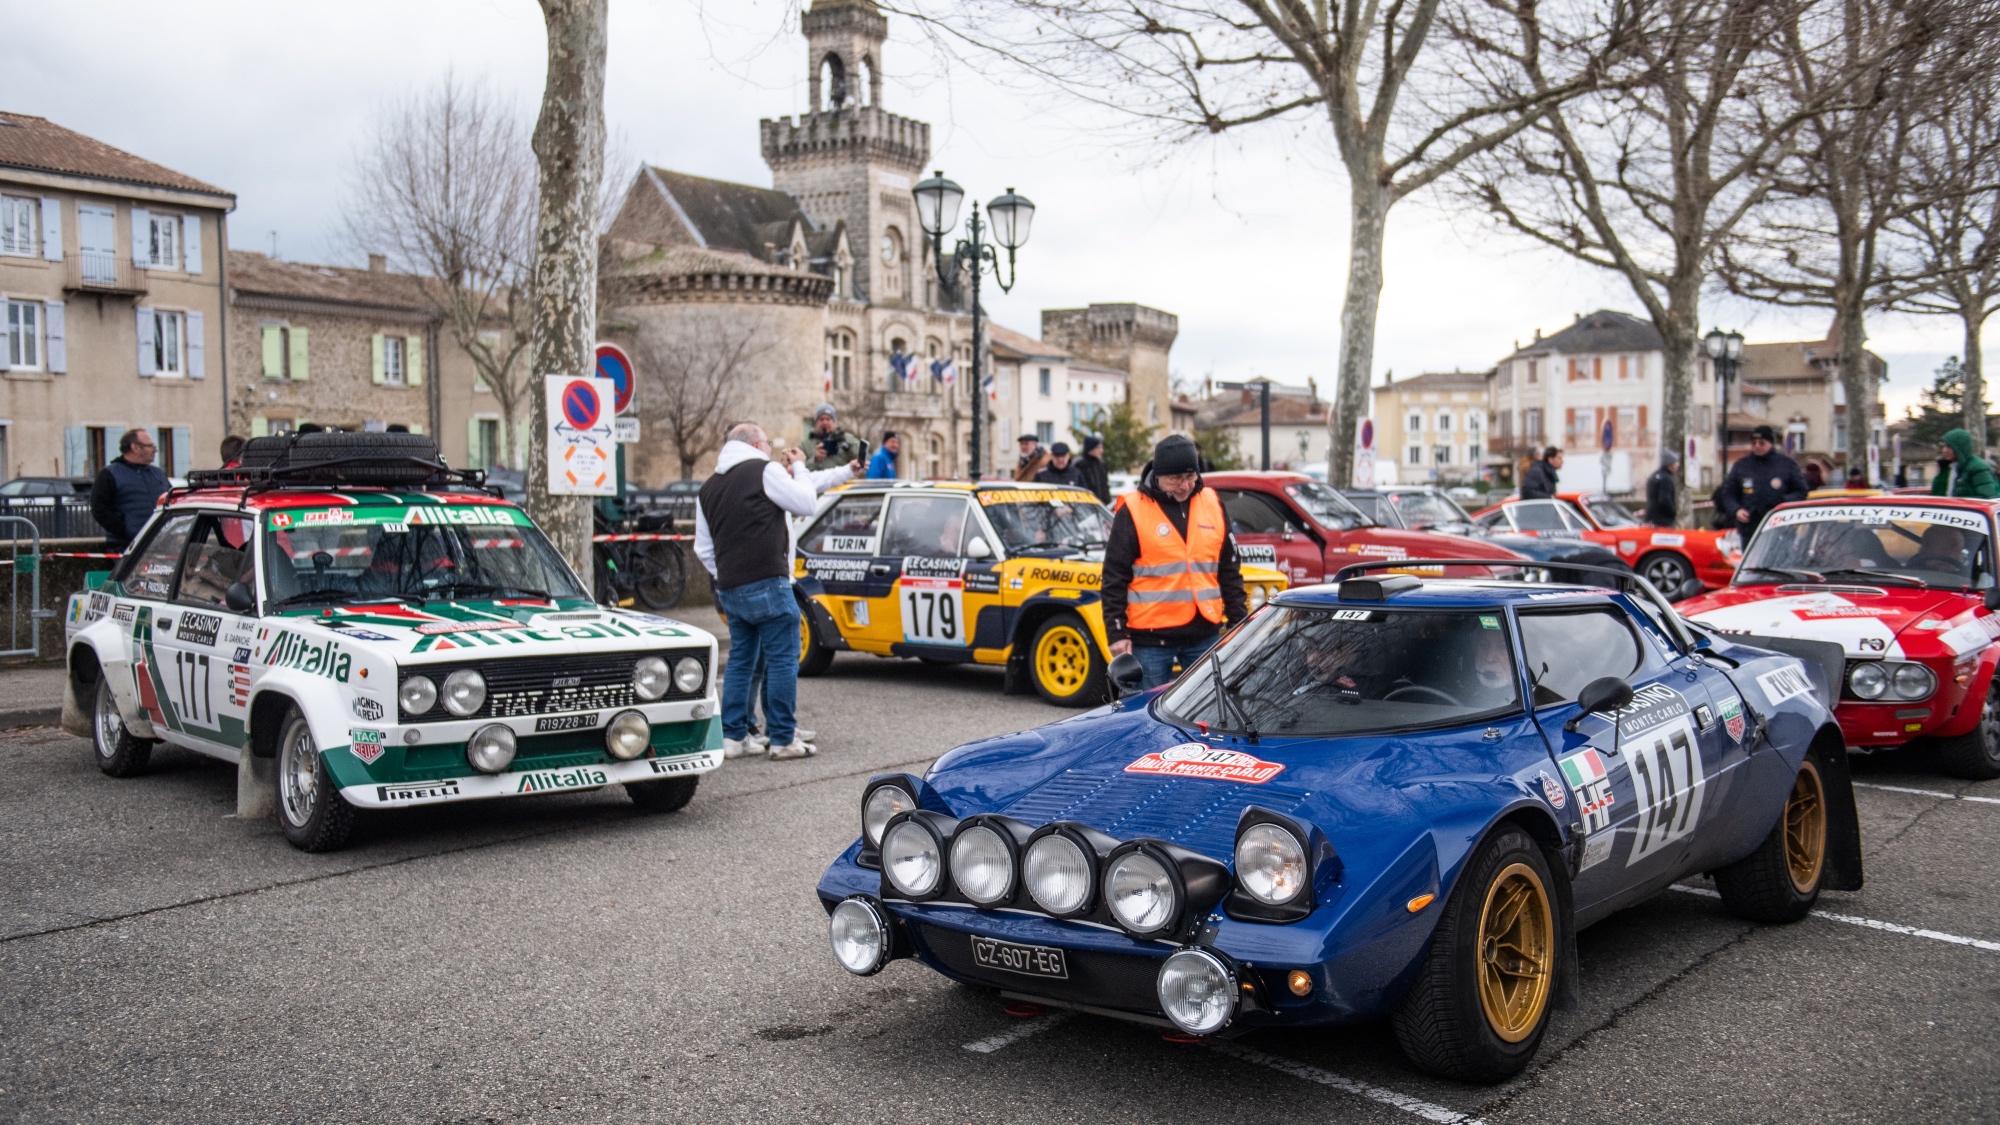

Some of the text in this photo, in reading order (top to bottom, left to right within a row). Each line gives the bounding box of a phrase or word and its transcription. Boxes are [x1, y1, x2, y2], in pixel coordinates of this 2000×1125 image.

[403, 506, 515, 525] Alitalia
[1783, 508, 1982, 530] UTORALLY by Filippi
[831, 537, 868, 550] TURIN
[805, 558, 871, 571] CONCESSIONARI
[907, 558, 960, 571] LE CASINO
[815, 569, 866, 581] FIAT VENETI
[1031, 567, 1075, 583] ROMBI
[89, 592, 111, 612] TURIN
[112, 603, 135, 622] PIRELLI
[180, 611, 220, 634] LE CASINO
[908, 591, 957, 640] 179
[1340, 610, 1365, 620] 147
[263, 630, 352, 683] Alitalia
[176, 650, 213, 724] 177
[1767, 667, 1811, 698] TURIN
[491, 690, 544, 717] FIAT
[1722, 701, 1741, 720] TAG
[540, 718, 579, 730] R19728
[355, 731, 377, 742] TAG
[355, 743, 381, 760] HEUER
[1201, 751, 1236, 763] 147
[649, 753, 715, 774] PIRELLI
[1132, 757, 1272, 779] RALLYE MONTE-CARLO
[377, 780, 460, 801] PIRELLI
[517, 768, 608, 793] Alitalia
[1636, 727, 1694, 854] 147
[976, 942, 1061, 973] CZ-607-EG
